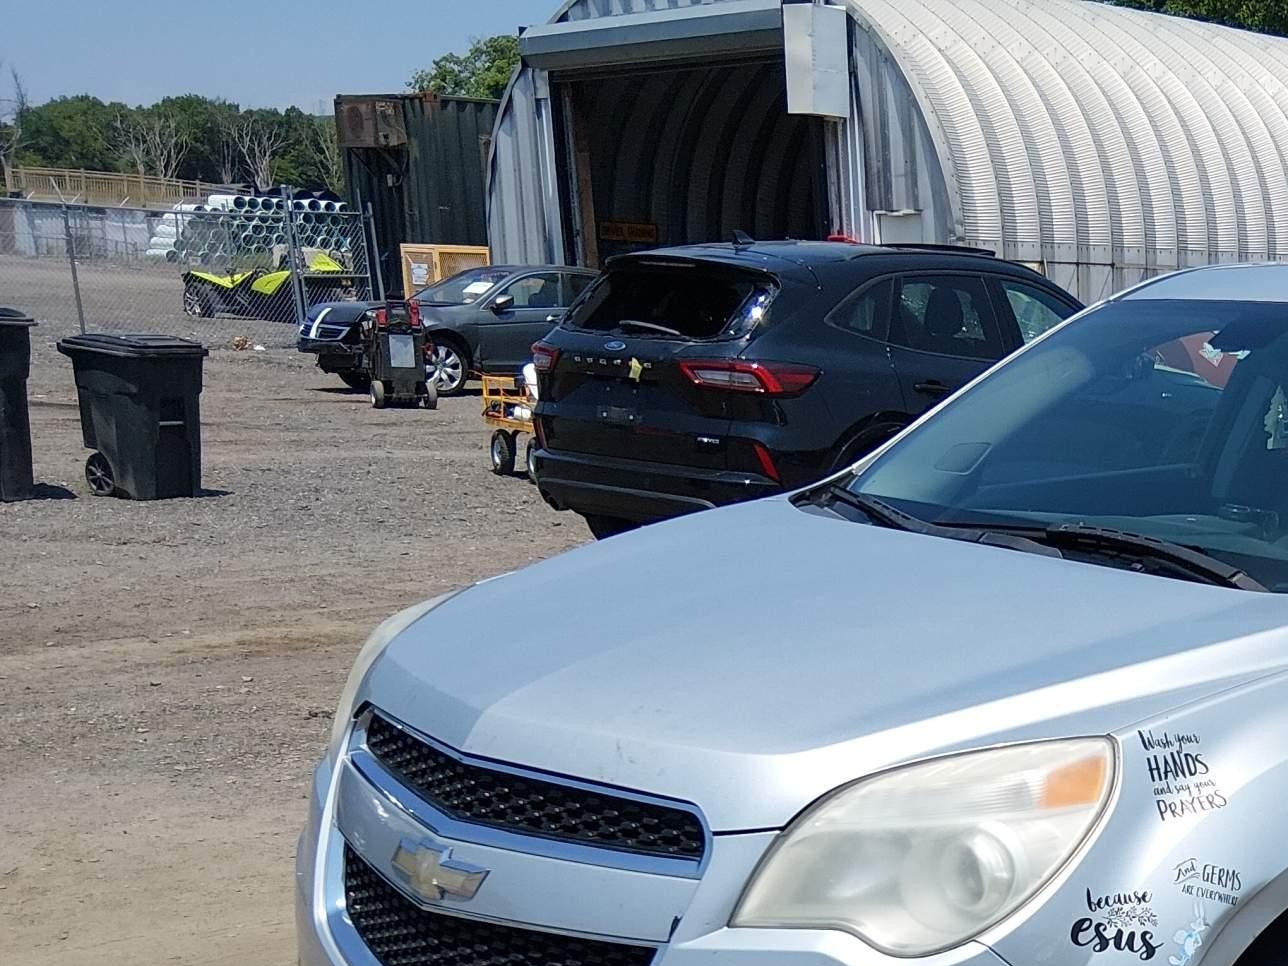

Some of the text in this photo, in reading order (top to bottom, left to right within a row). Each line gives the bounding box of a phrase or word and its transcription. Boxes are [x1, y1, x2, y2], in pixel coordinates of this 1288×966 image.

[1137, 730, 1201, 753] Wash your
[1146, 750, 1209, 782] HANDS
[1153, 779, 1216, 797] and say your
[1156, 789, 1227, 822] PRAYERS
[1174, 860, 1242, 892] And GERMS
[1086, 887, 1152, 912] because
[1181, 883, 1195, 896] ARE
